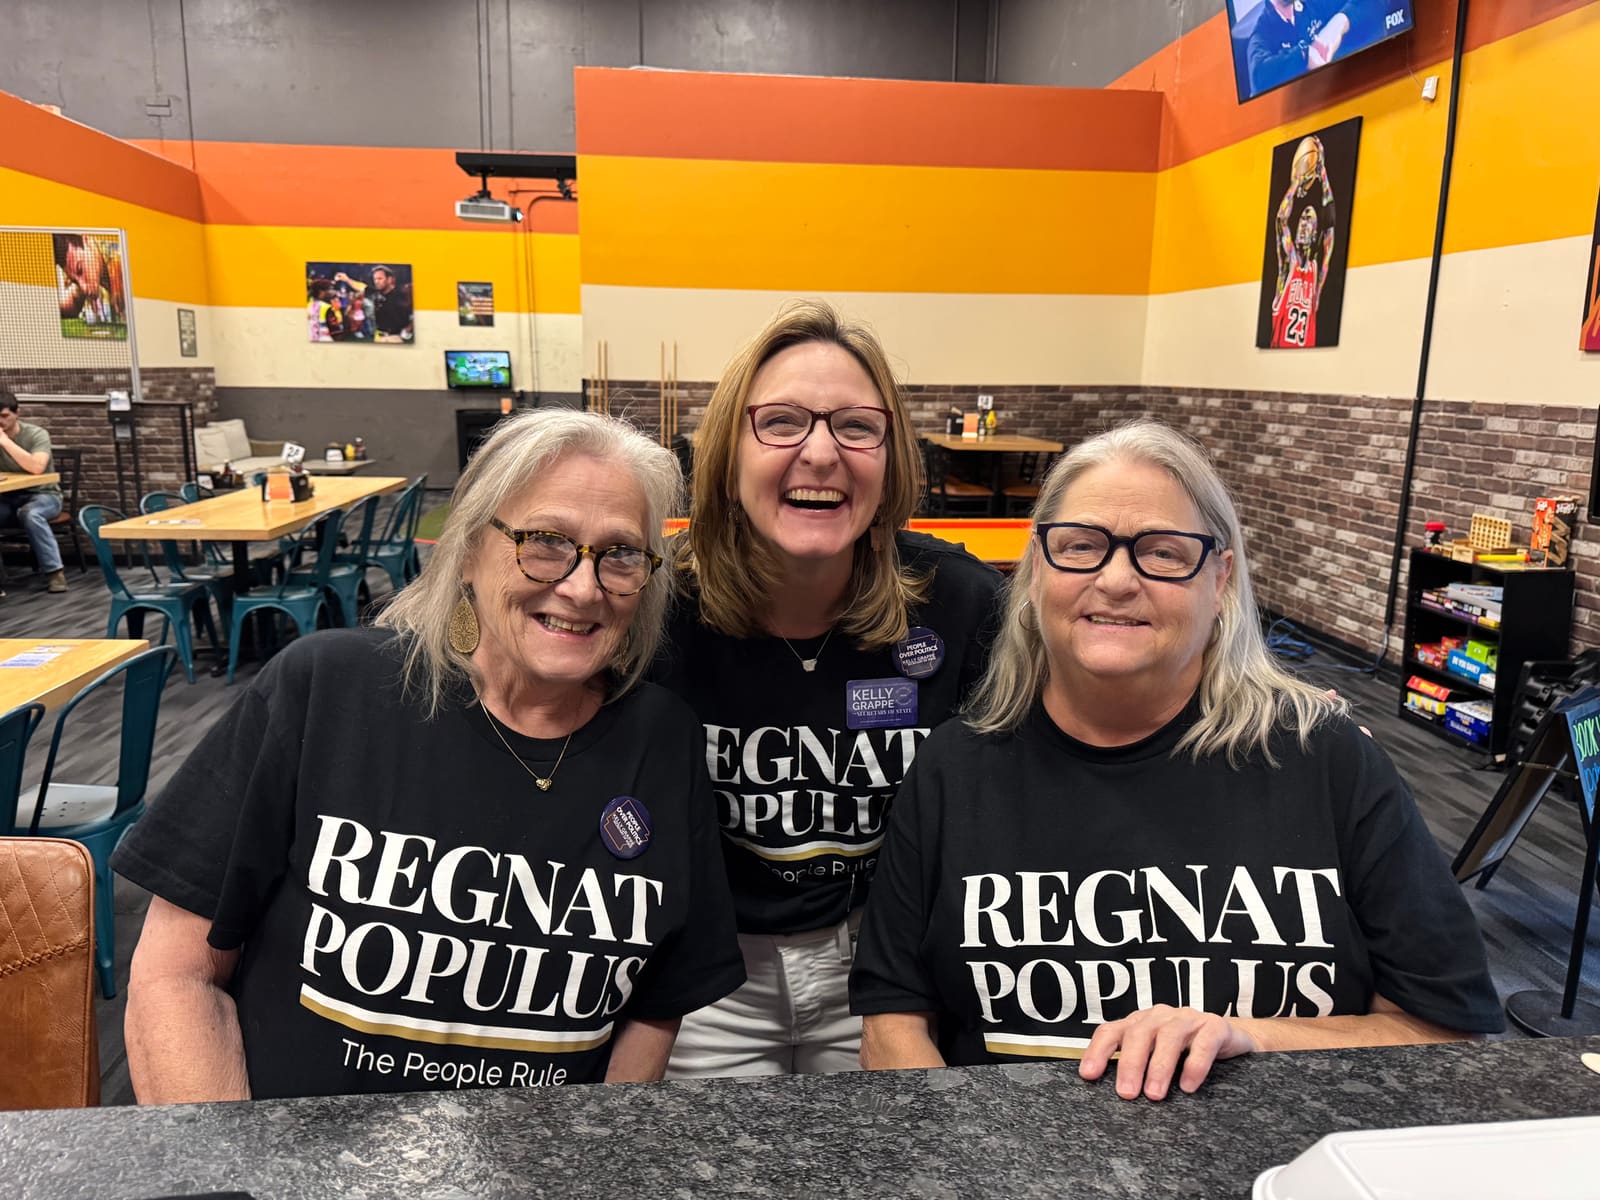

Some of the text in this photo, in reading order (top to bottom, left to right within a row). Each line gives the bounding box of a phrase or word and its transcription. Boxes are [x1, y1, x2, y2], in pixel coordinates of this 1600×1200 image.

[1385, 9, 1405, 29] FOX
[1285, 307, 1309, 346] 23
[898, 650, 914, 659] OVER
[906, 642, 927, 651] PEOPLE
[852, 687, 894, 701] KELLY
[852, 699, 895, 711] GRAPPE
[702, 724, 931, 788] EGNAT
[616, 807, 628, 822] OVER
[626, 811, 641, 831] PEOPLE
[713, 789, 893, 838] OPULU
[307, 814, 664, 947] REGNAT
[960, 864, 1341, 948] REGNAT
[300, 903, 647, 1019] POPULUS
[966, 957, 1336, 1025] POPULUS
[342, 1038, 567, 1089] The People Rule
